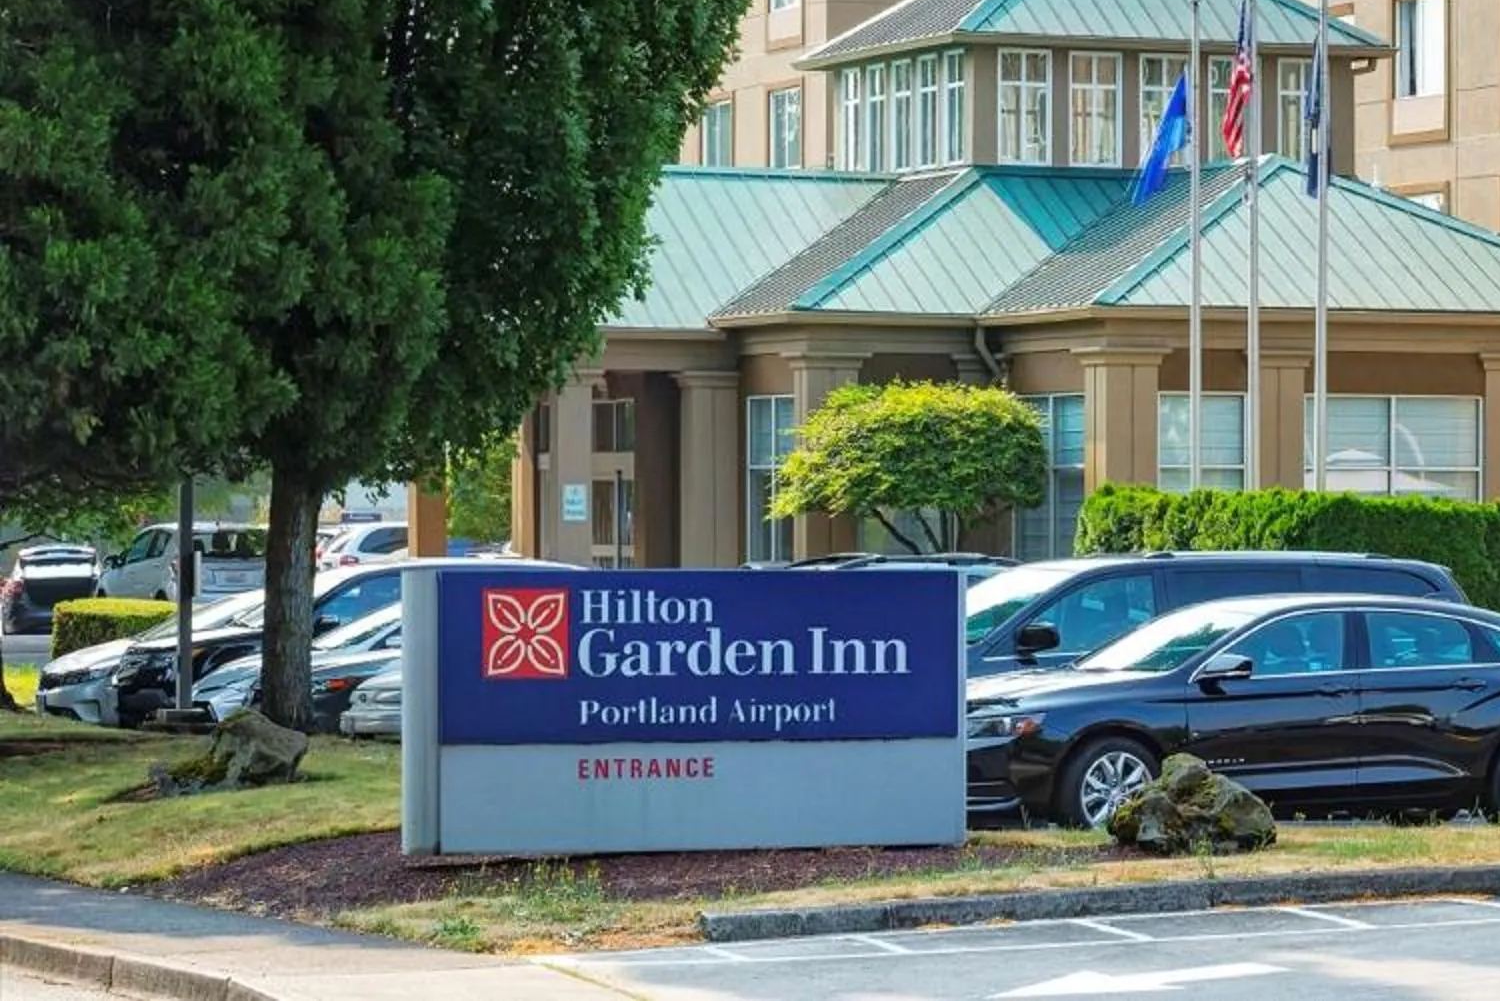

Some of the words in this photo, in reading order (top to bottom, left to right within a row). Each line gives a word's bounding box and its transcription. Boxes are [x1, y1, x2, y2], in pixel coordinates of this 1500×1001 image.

[579, 589, 713, 624] Hilton
[577, 627, 798, 678] Garden
[807, 626, 912, 675] Inn
[579, 696, 718, 725] Portland
[729, 697, 835, 732] Airport
[578, 757, 715, 780] ENTRANCE
